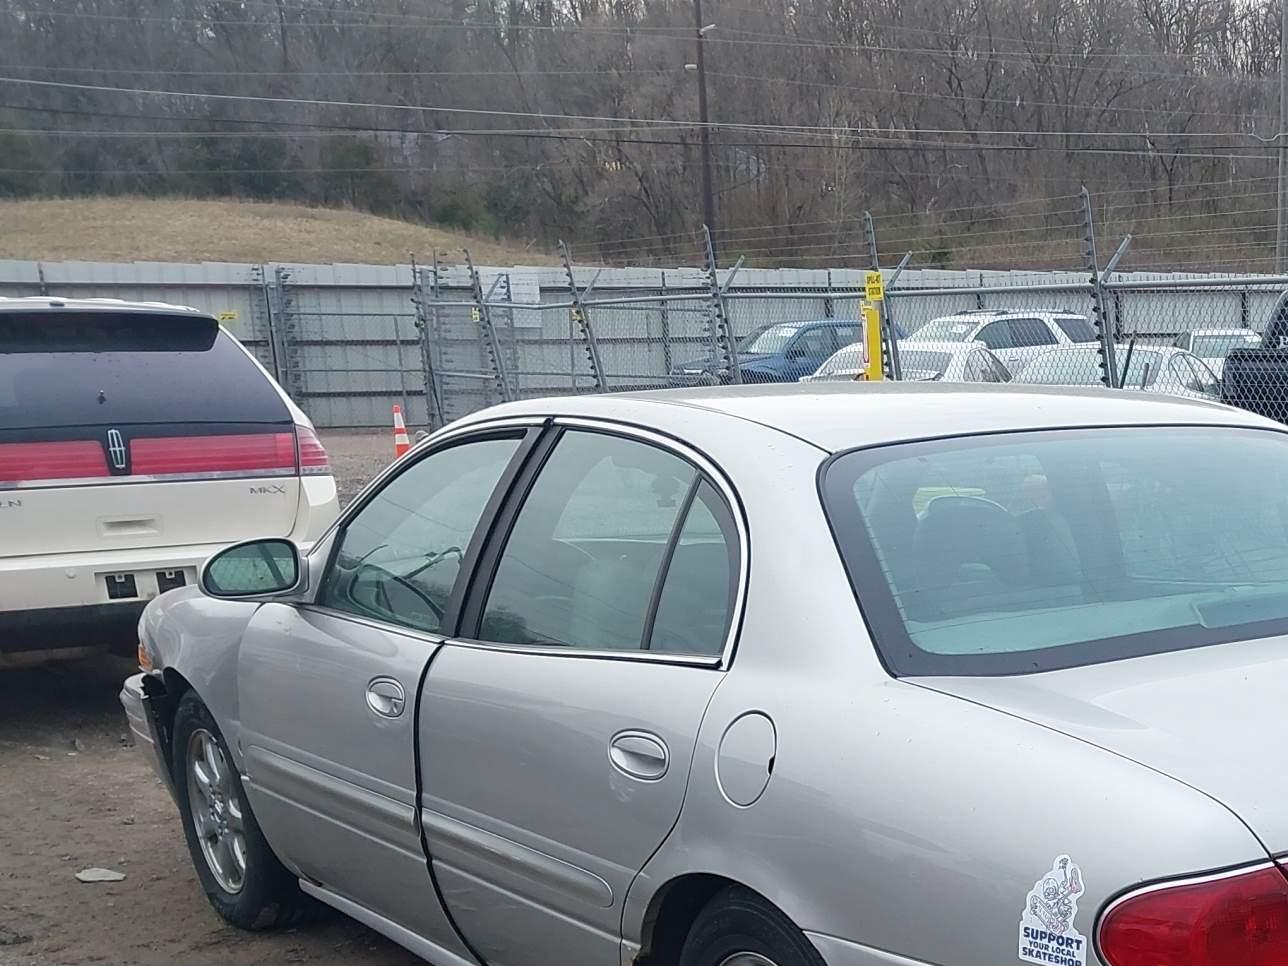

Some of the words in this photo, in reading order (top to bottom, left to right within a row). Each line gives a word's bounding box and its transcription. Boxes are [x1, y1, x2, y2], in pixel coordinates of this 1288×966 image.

[249, 485, 286, 495] MKX
[1023, 926, 1082, 950] SUPPORT
[1028, 940, 1050, 952] YOUR
[1051, 945, 1077, 959] LOCAL
